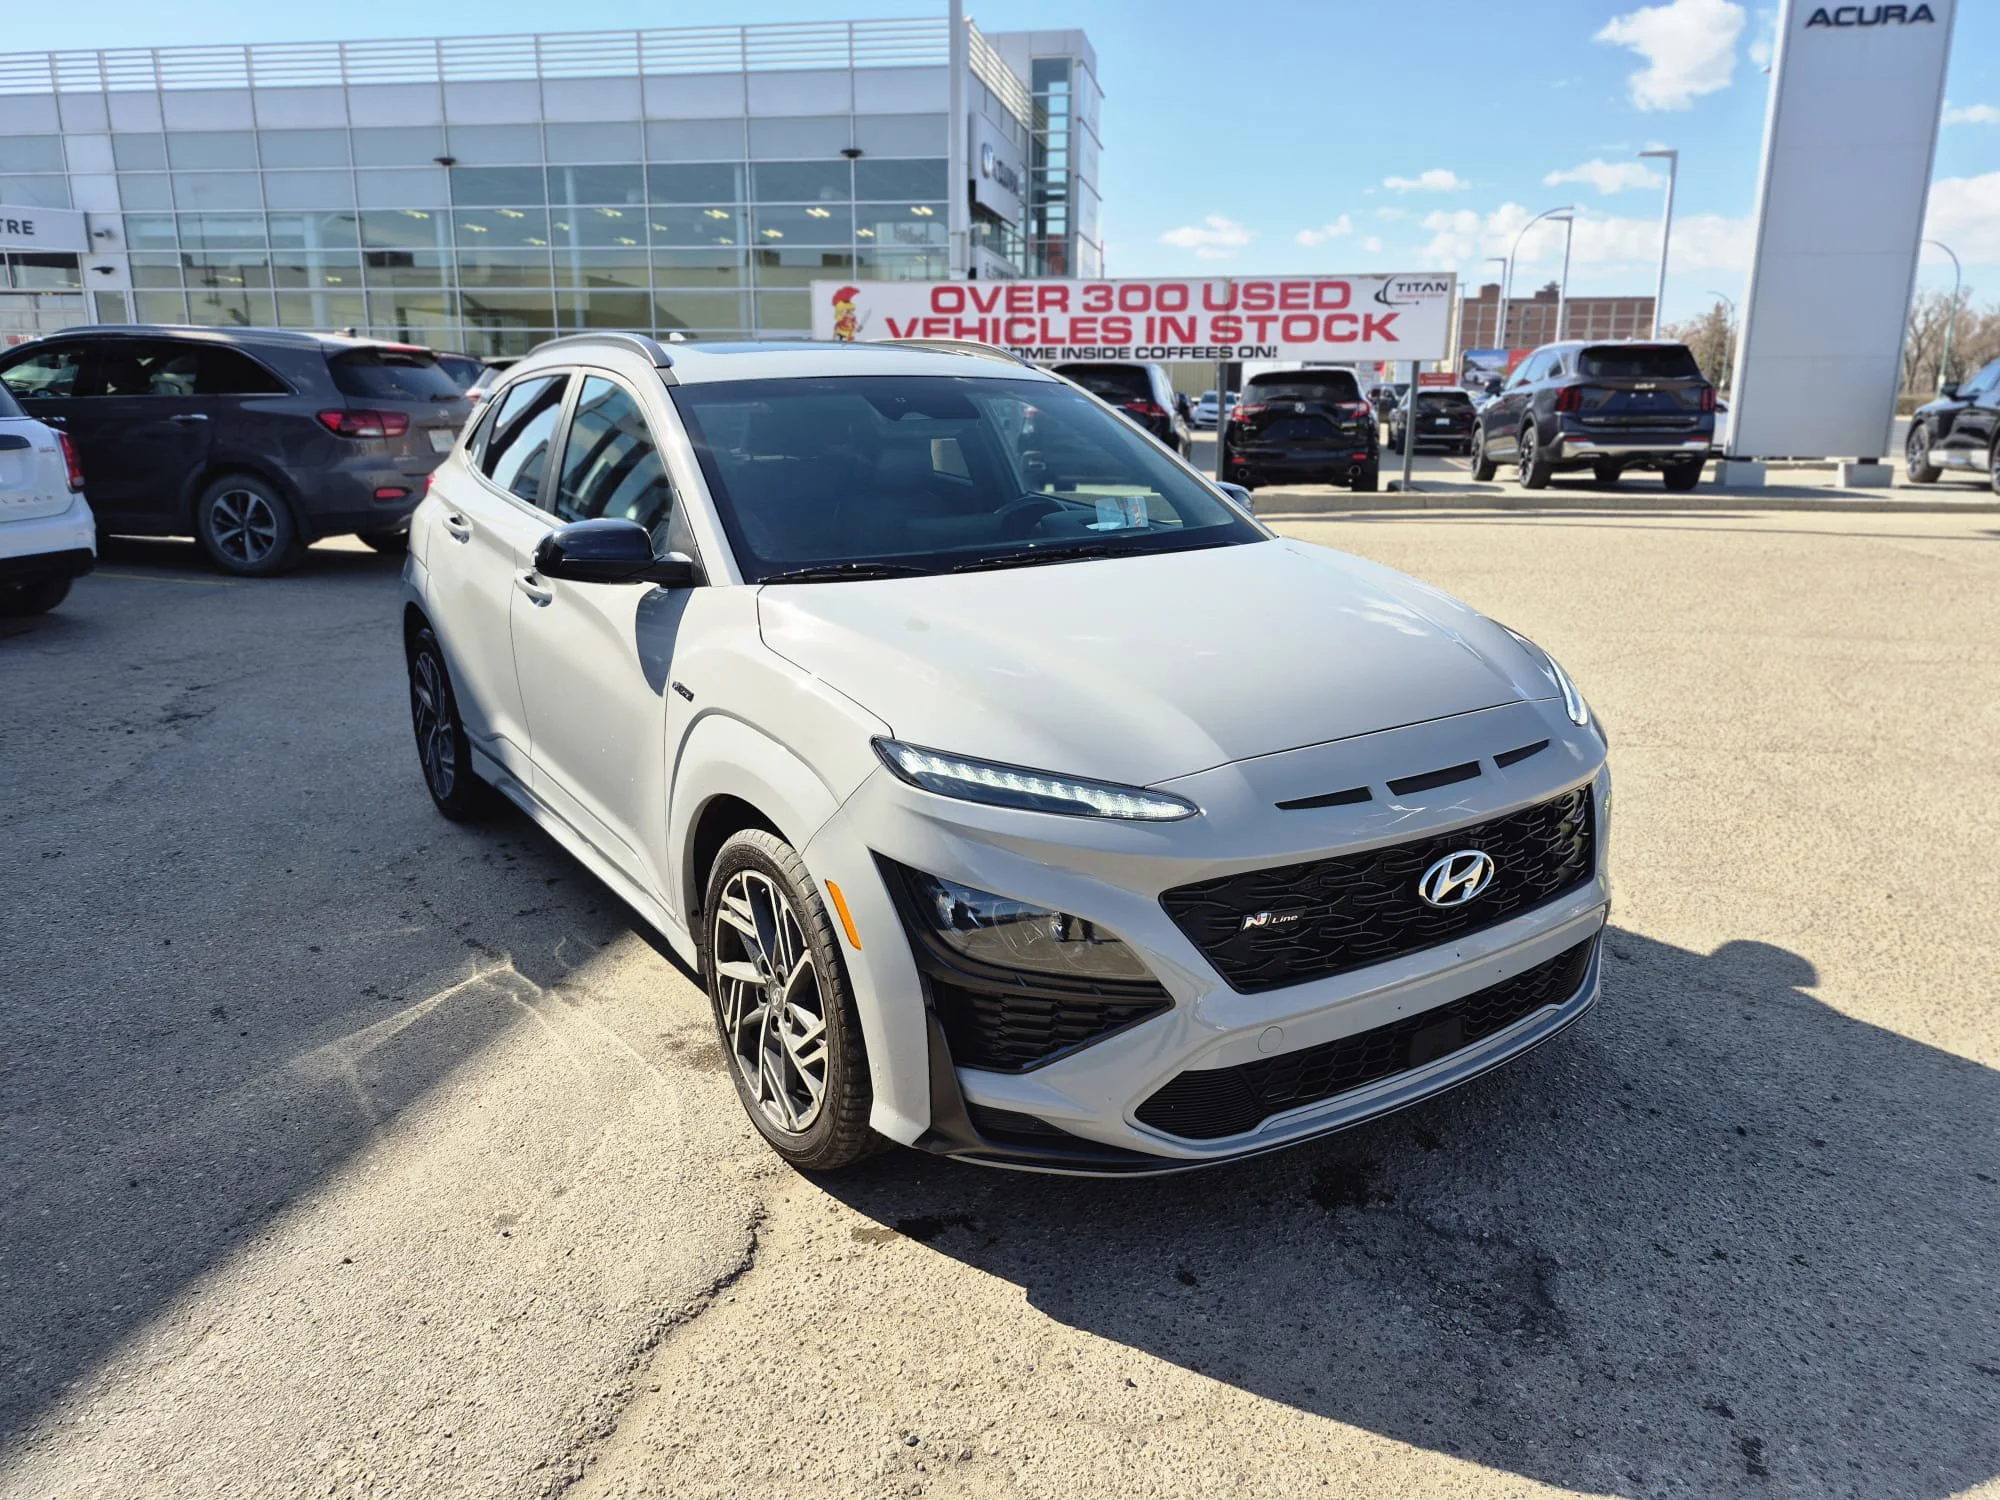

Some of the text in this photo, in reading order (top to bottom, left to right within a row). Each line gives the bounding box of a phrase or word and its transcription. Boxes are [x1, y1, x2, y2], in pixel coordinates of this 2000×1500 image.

[1806, 4, 1935, 28] ACURA
[931, 281, 1352, 314] OVER 300 USED
[1396, 282, 1448, 292] TITAN
[885, 313, 1400, 345] VEHICLES IN STOCK
[1004, 345, 1278, 360] OME INSIDE COFFEES ON!
